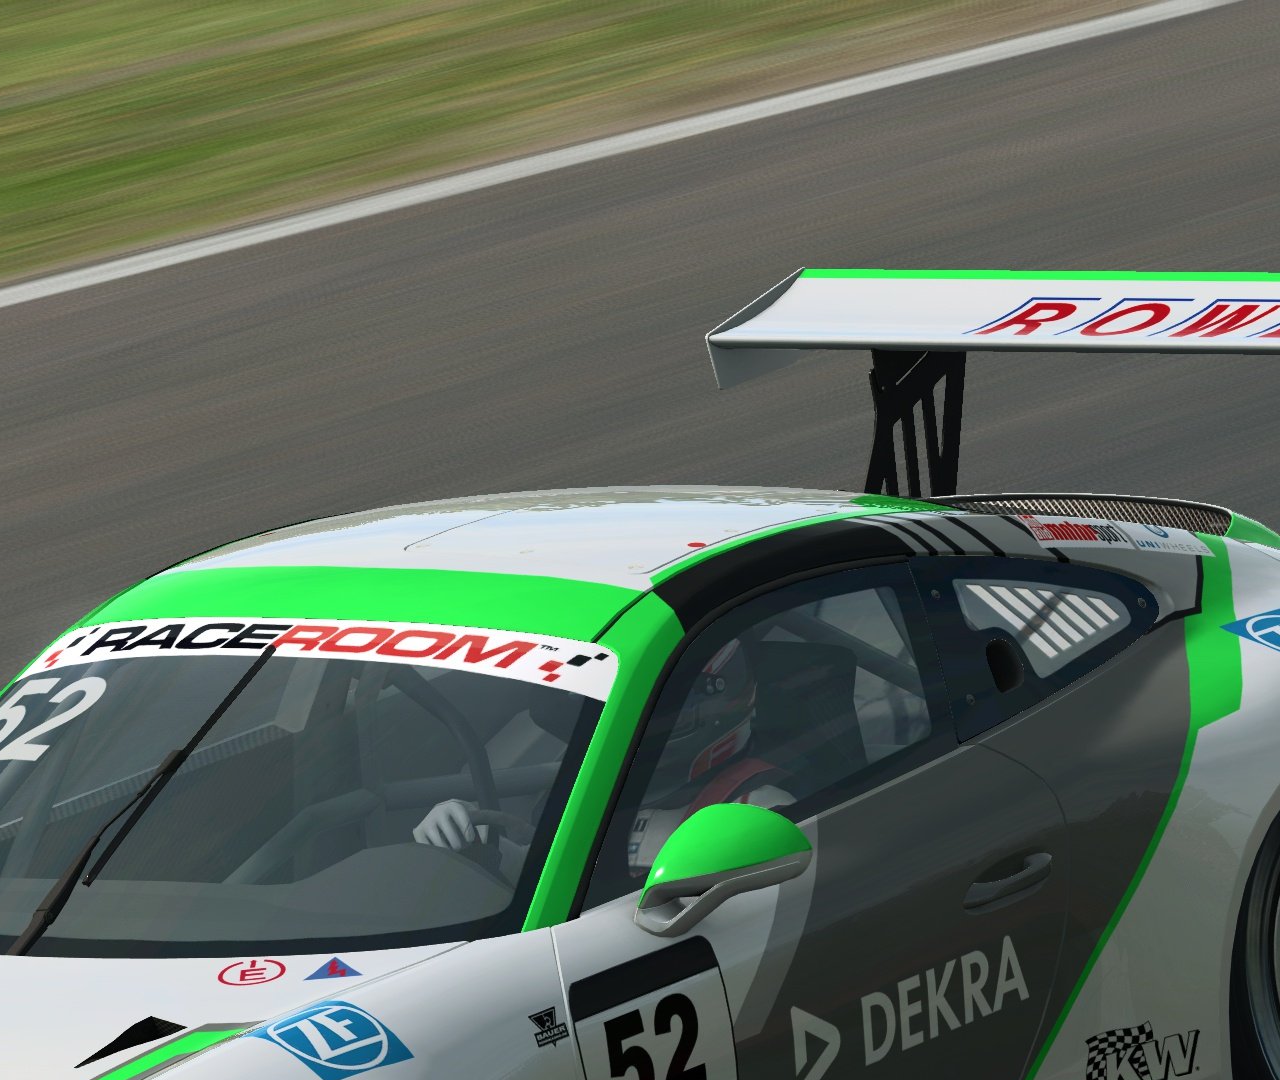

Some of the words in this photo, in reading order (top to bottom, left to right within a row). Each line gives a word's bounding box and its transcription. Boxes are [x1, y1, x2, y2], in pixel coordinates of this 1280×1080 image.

[1135, 539, 1211, 555] UNIWHEELS
[860, 935, 1030, 1067] DEKRA
[272, 1006, 384, 1061] ZF
[536, 1025, 566, 1041] BAUER
